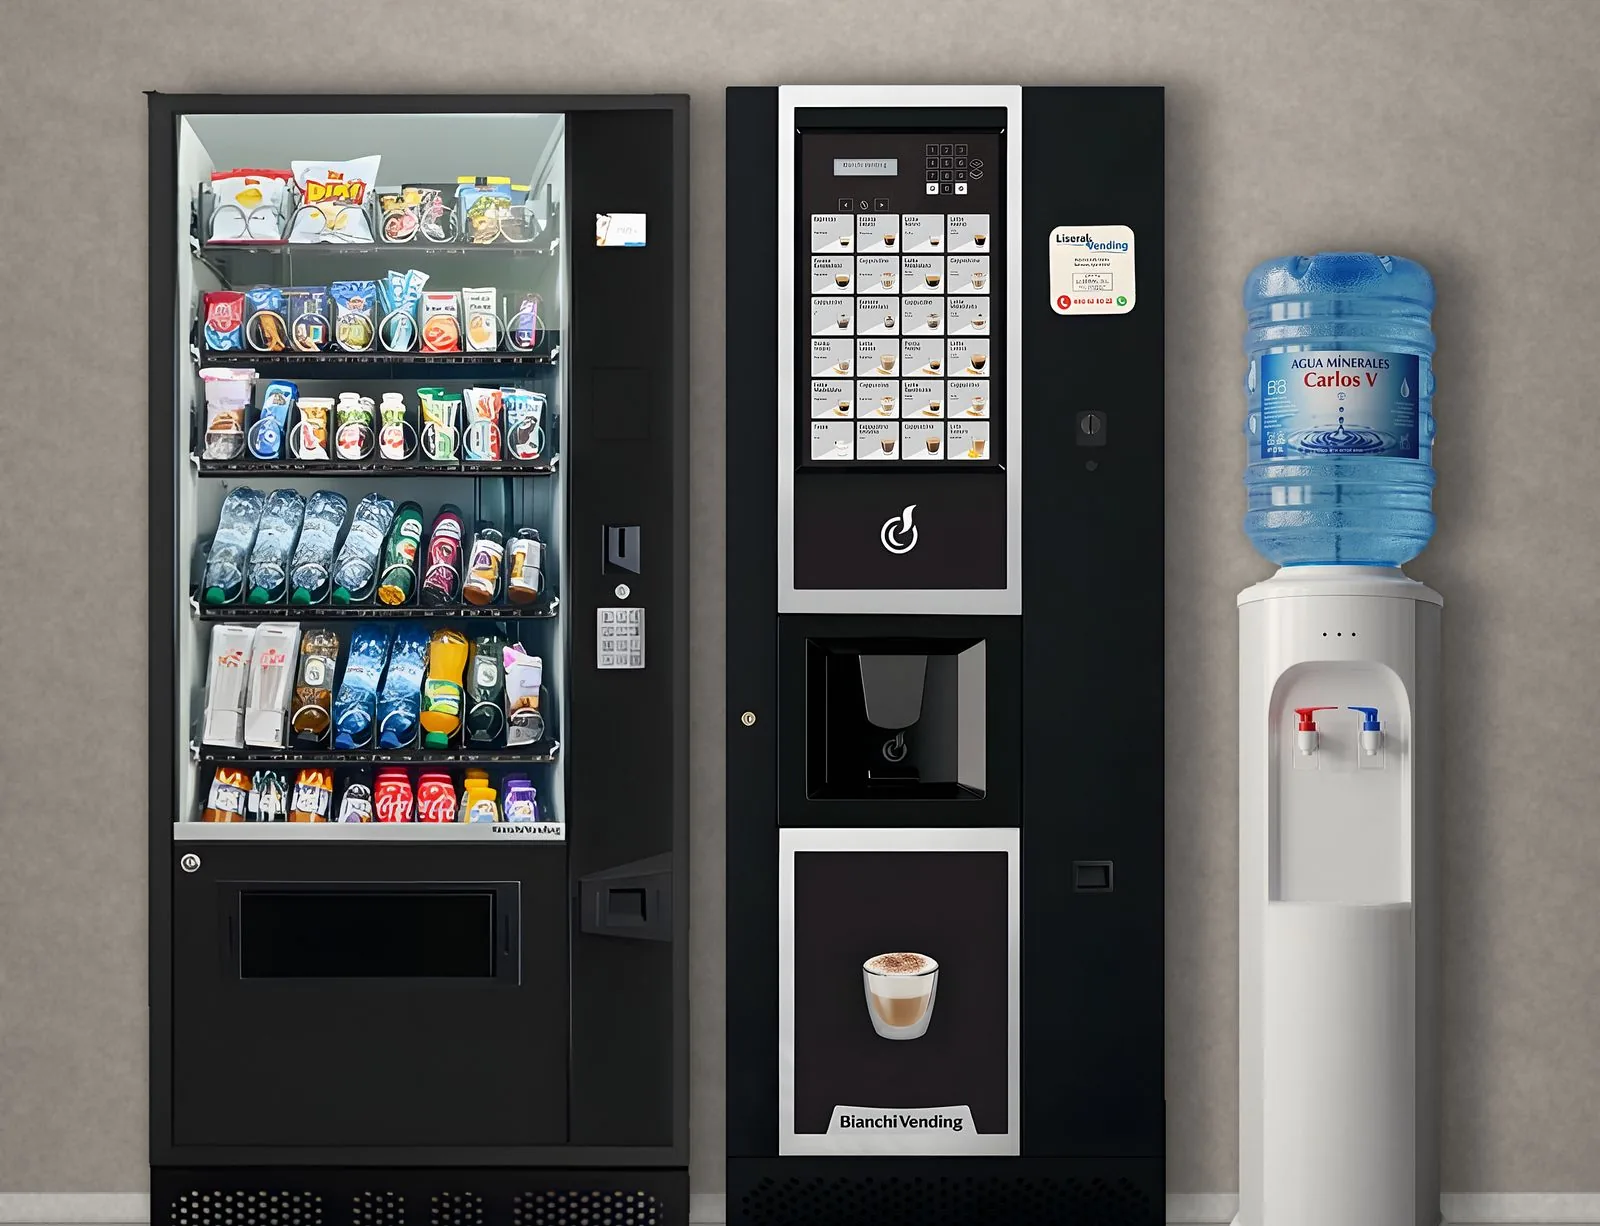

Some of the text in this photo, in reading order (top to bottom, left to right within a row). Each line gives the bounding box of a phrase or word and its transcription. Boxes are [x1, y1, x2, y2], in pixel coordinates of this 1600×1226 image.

[1086, 241, 1129, 252] Vending
[1291, 358, 1323, 369] AGUA
[1304, 370, 1378, 388] Carlos V
[839, 1114, 964, 1132] Bianchi Vending
